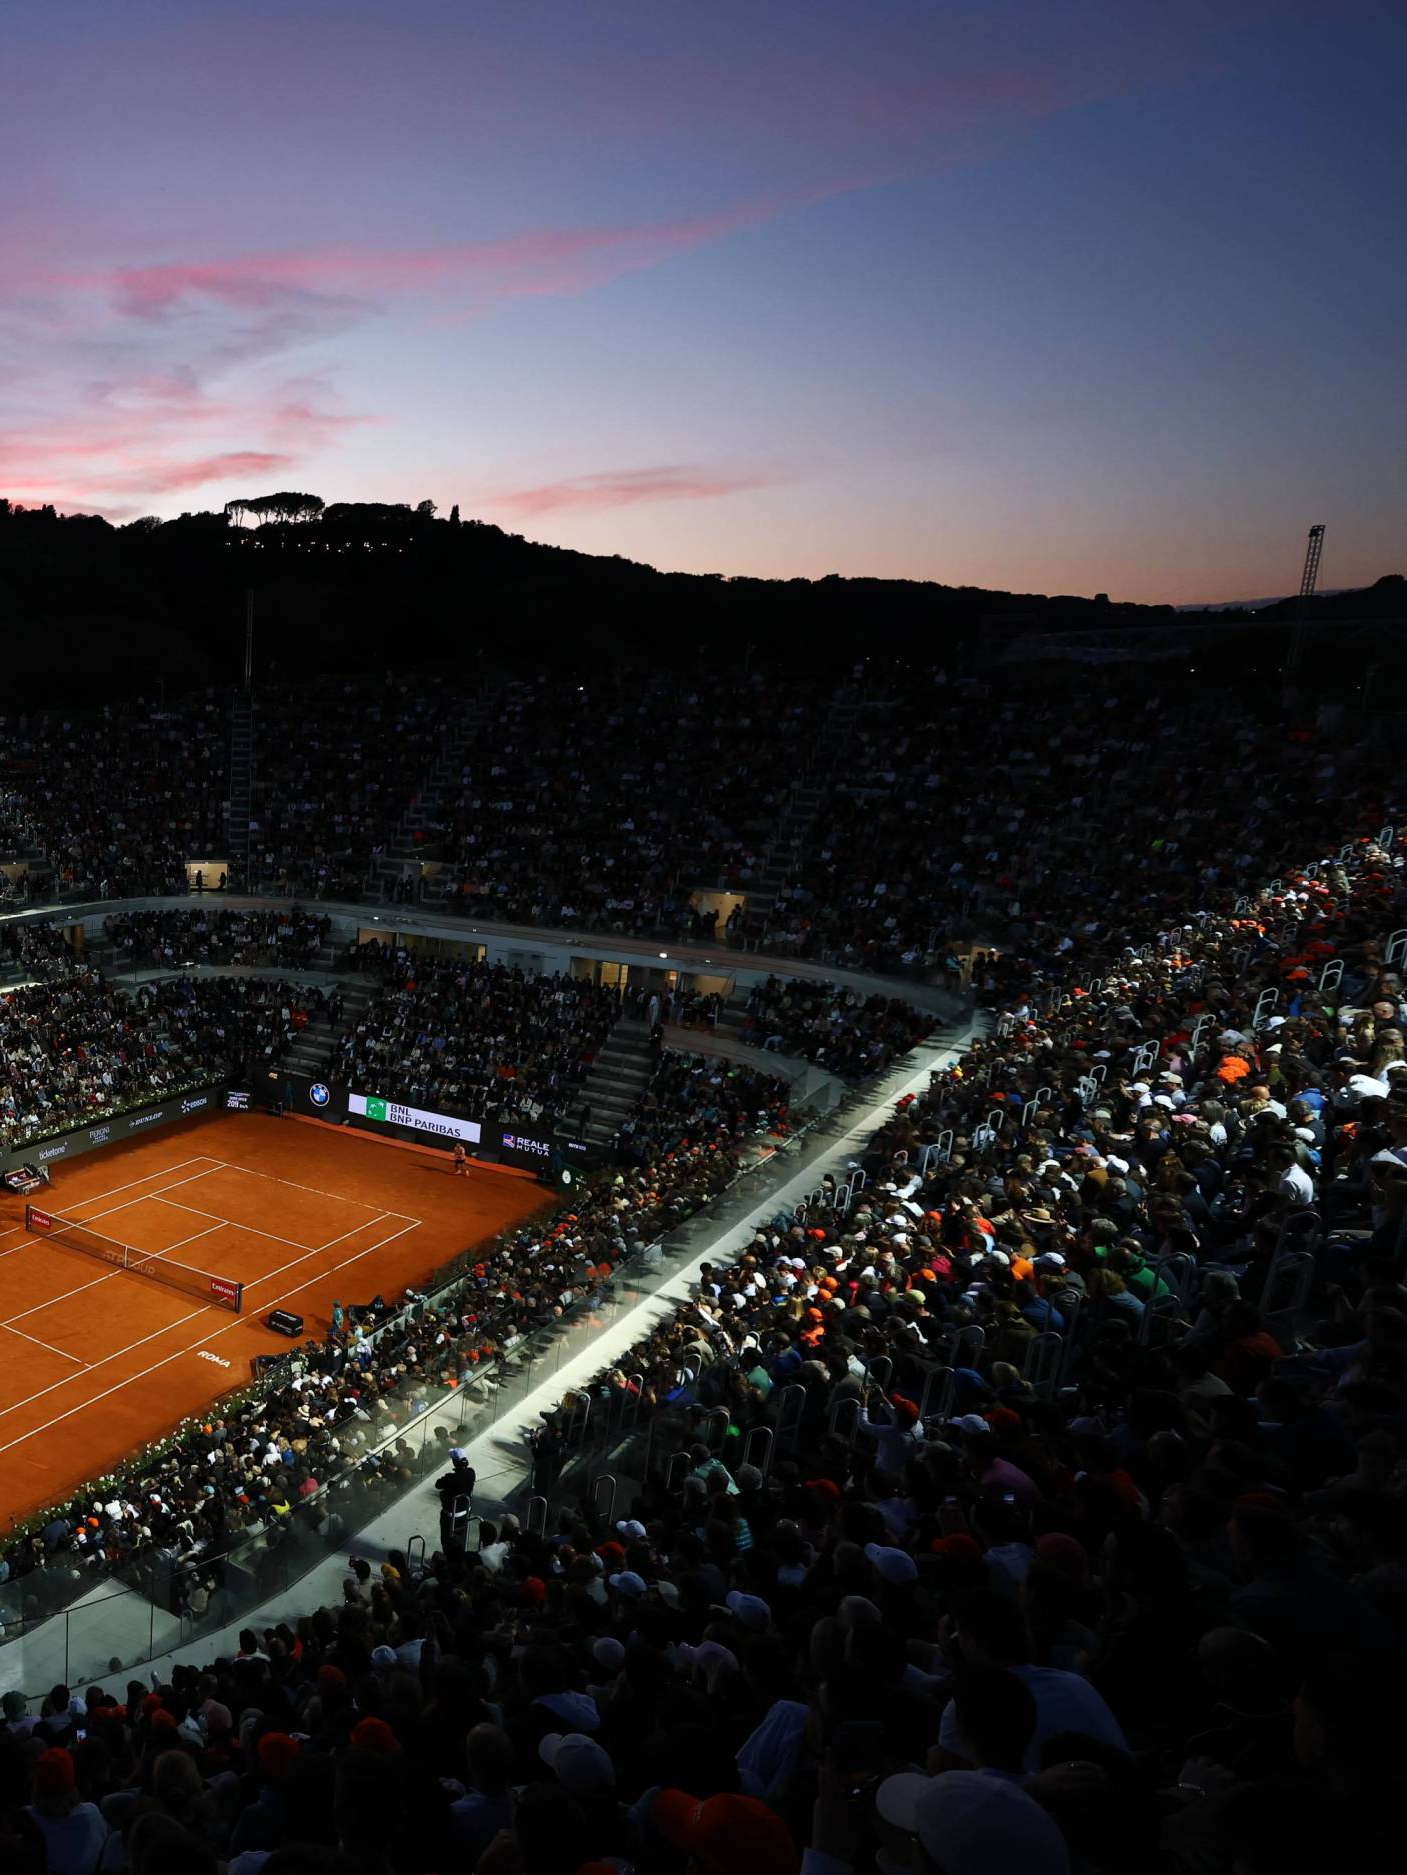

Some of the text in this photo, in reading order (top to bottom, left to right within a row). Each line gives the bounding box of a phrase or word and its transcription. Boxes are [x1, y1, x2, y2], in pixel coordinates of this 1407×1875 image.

[226, 1100, 239, 1108] 209
[390, 1104, 411, 1117] BNL
[134, 1111, 163, 1126] DUNLOP
[389, 1113, 461, 1138] BNP PARIBAS
[89, 1126, 110, 1139] PERONI
[516, 1137, 550, 1152] REALE
[516, 1144, 550, 1157] MUTUA
[197, 1350, 231, 1368] ROMA
